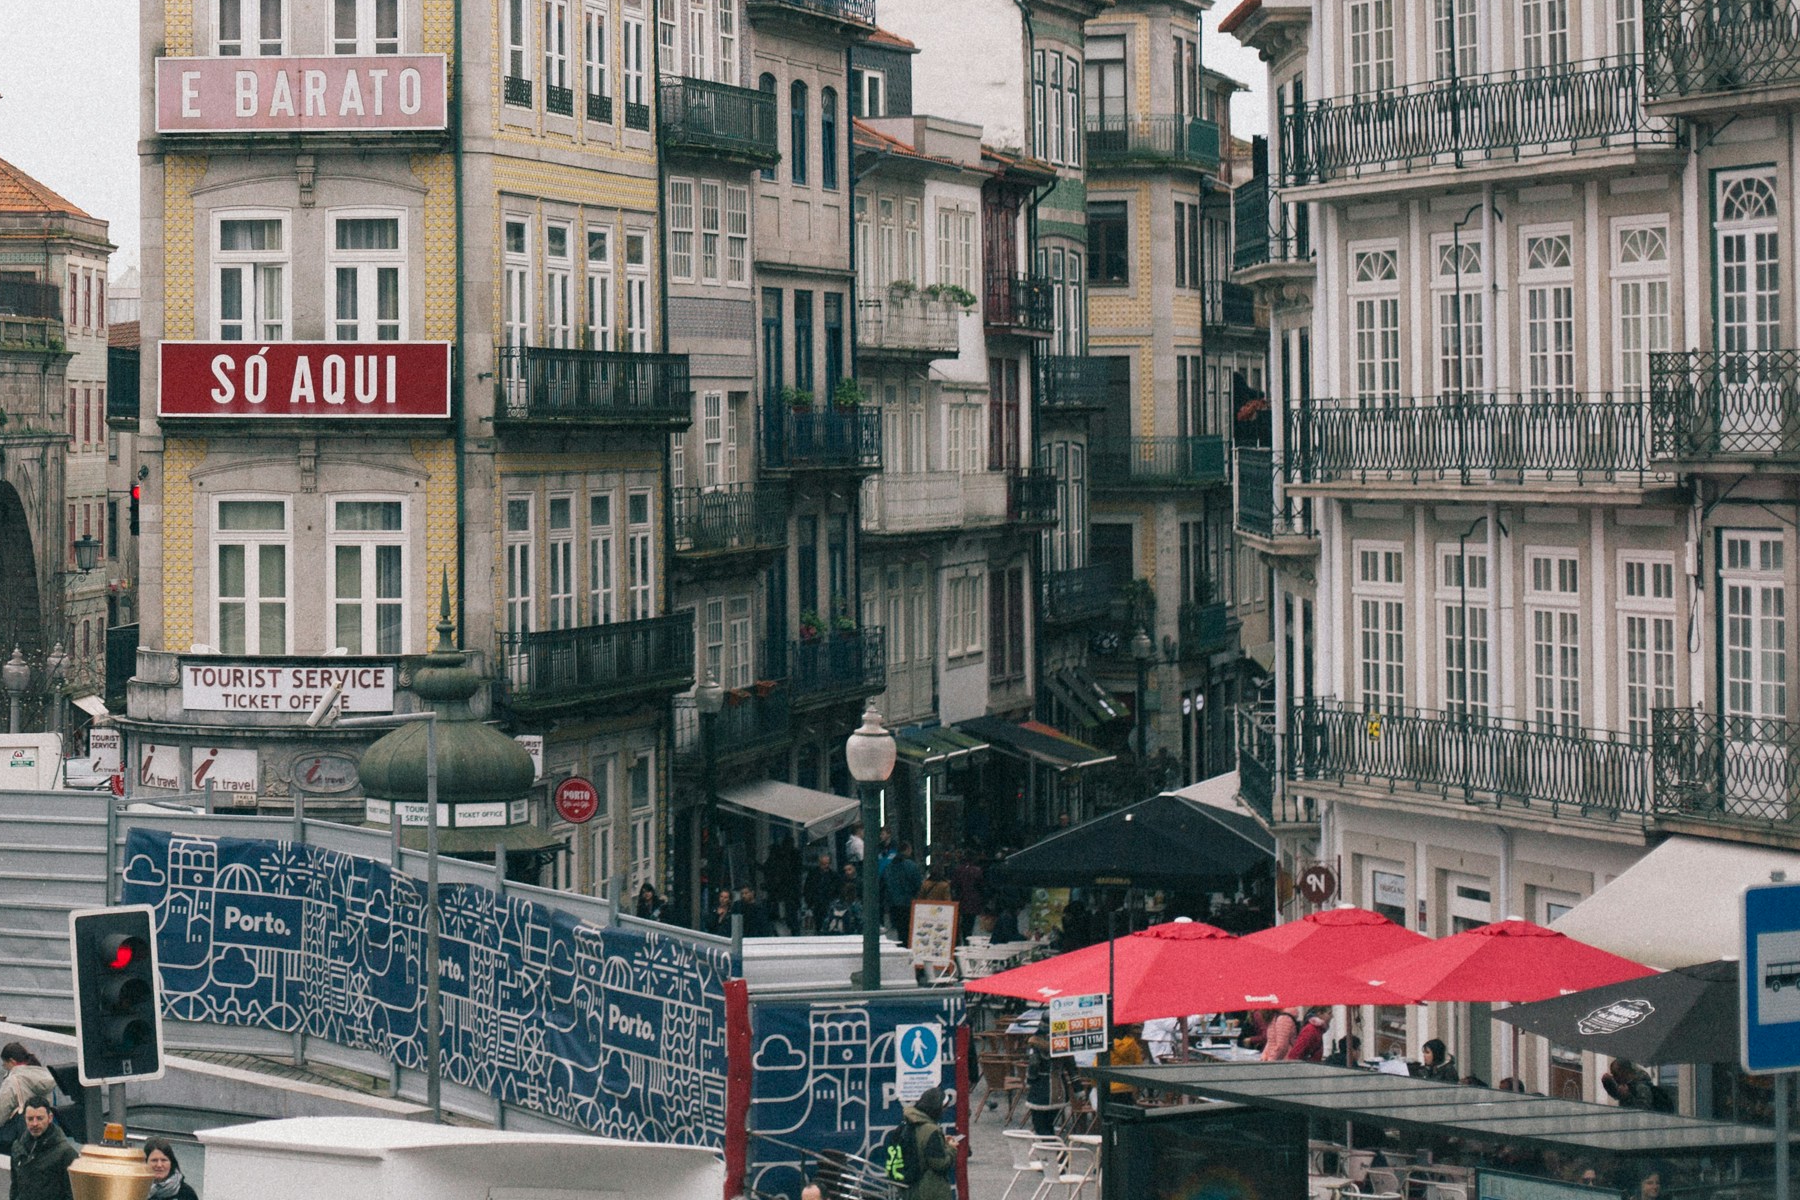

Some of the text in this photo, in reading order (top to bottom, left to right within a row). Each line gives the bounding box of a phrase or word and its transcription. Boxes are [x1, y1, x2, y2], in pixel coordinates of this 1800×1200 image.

[182, 68, 422, 117] E BARATO
[211, 346, 397, 404] SÓ AQUI
[190, 668, 385, 689] TOURIST SERVICE
[222, 694, 350, 709] TICKET OFFE
[157, 776, 178, 788] travel
[223, 779, 255, 790] travel
[563, 790, 590, 800] PORTO
[405, 805, 429, 813] TOURI
[482, 810, 503, 818] OFFICE
[405, 814, 430, 822] SERVIC
[225, 906, 291, 936] Porto.
[609, 1003, 655, 1041] Porto.
